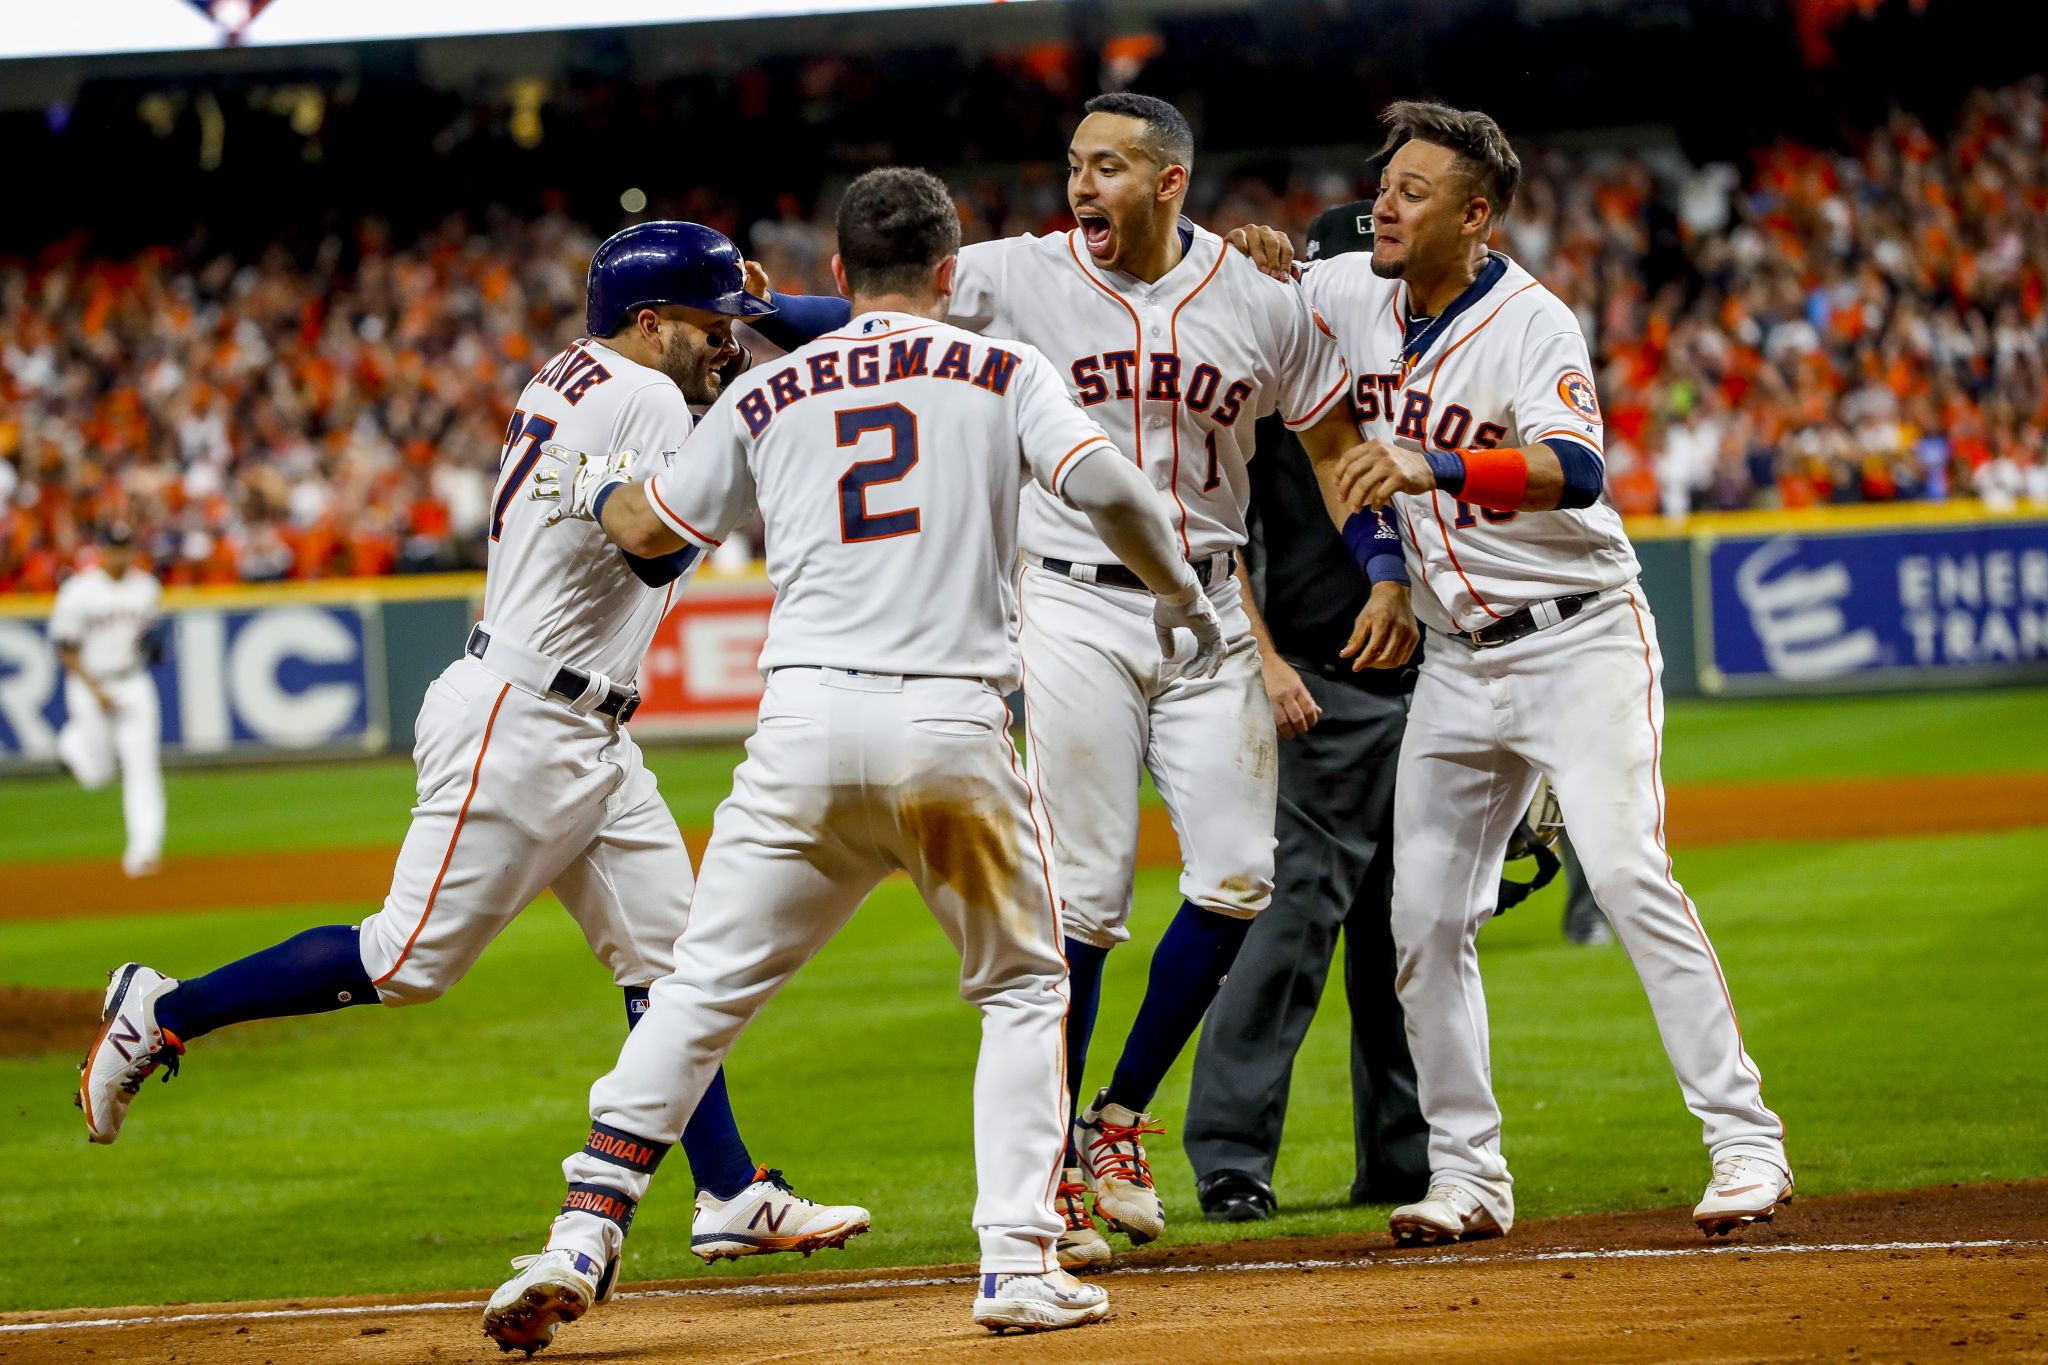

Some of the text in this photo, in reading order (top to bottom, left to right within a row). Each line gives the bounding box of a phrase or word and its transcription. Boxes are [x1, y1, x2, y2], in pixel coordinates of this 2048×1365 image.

[736, 337, 1022, 440] BREGMAN
[1071, 350, 1253, 427] STROS
[1357, 374, 1508, 451] STROS
[834, 401, 921, 544] 2
[1203, 429, 1221, 493] 1
[747, 1200, 793, 1232] N
